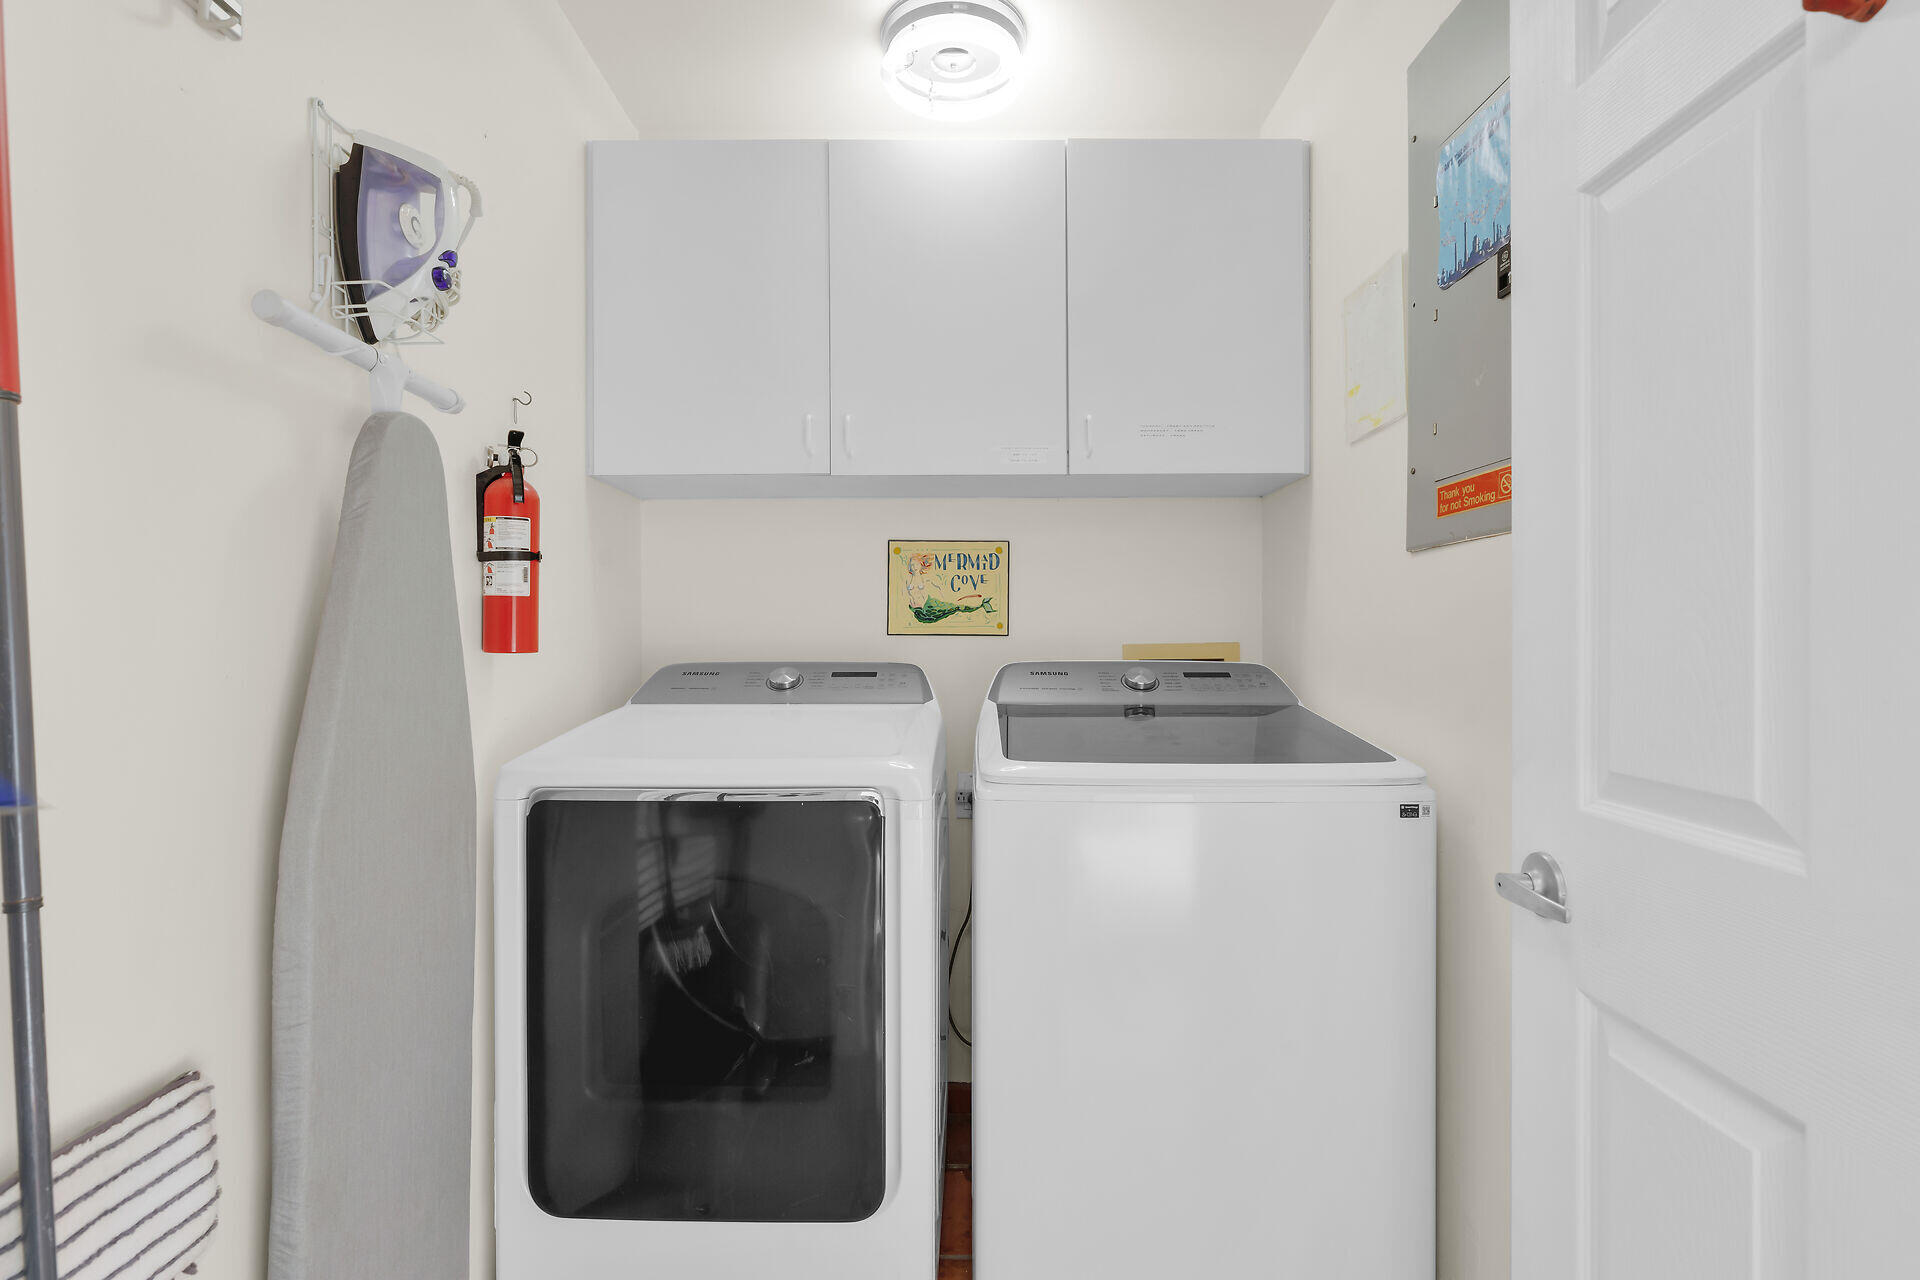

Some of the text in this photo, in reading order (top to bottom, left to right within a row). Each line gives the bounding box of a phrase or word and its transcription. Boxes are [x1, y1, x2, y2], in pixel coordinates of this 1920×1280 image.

[1440, 484, 1475, 501] Thank you
[1440, 490, 1496, 514] for not Smoking
[950, 574, 990, 593] COVE
